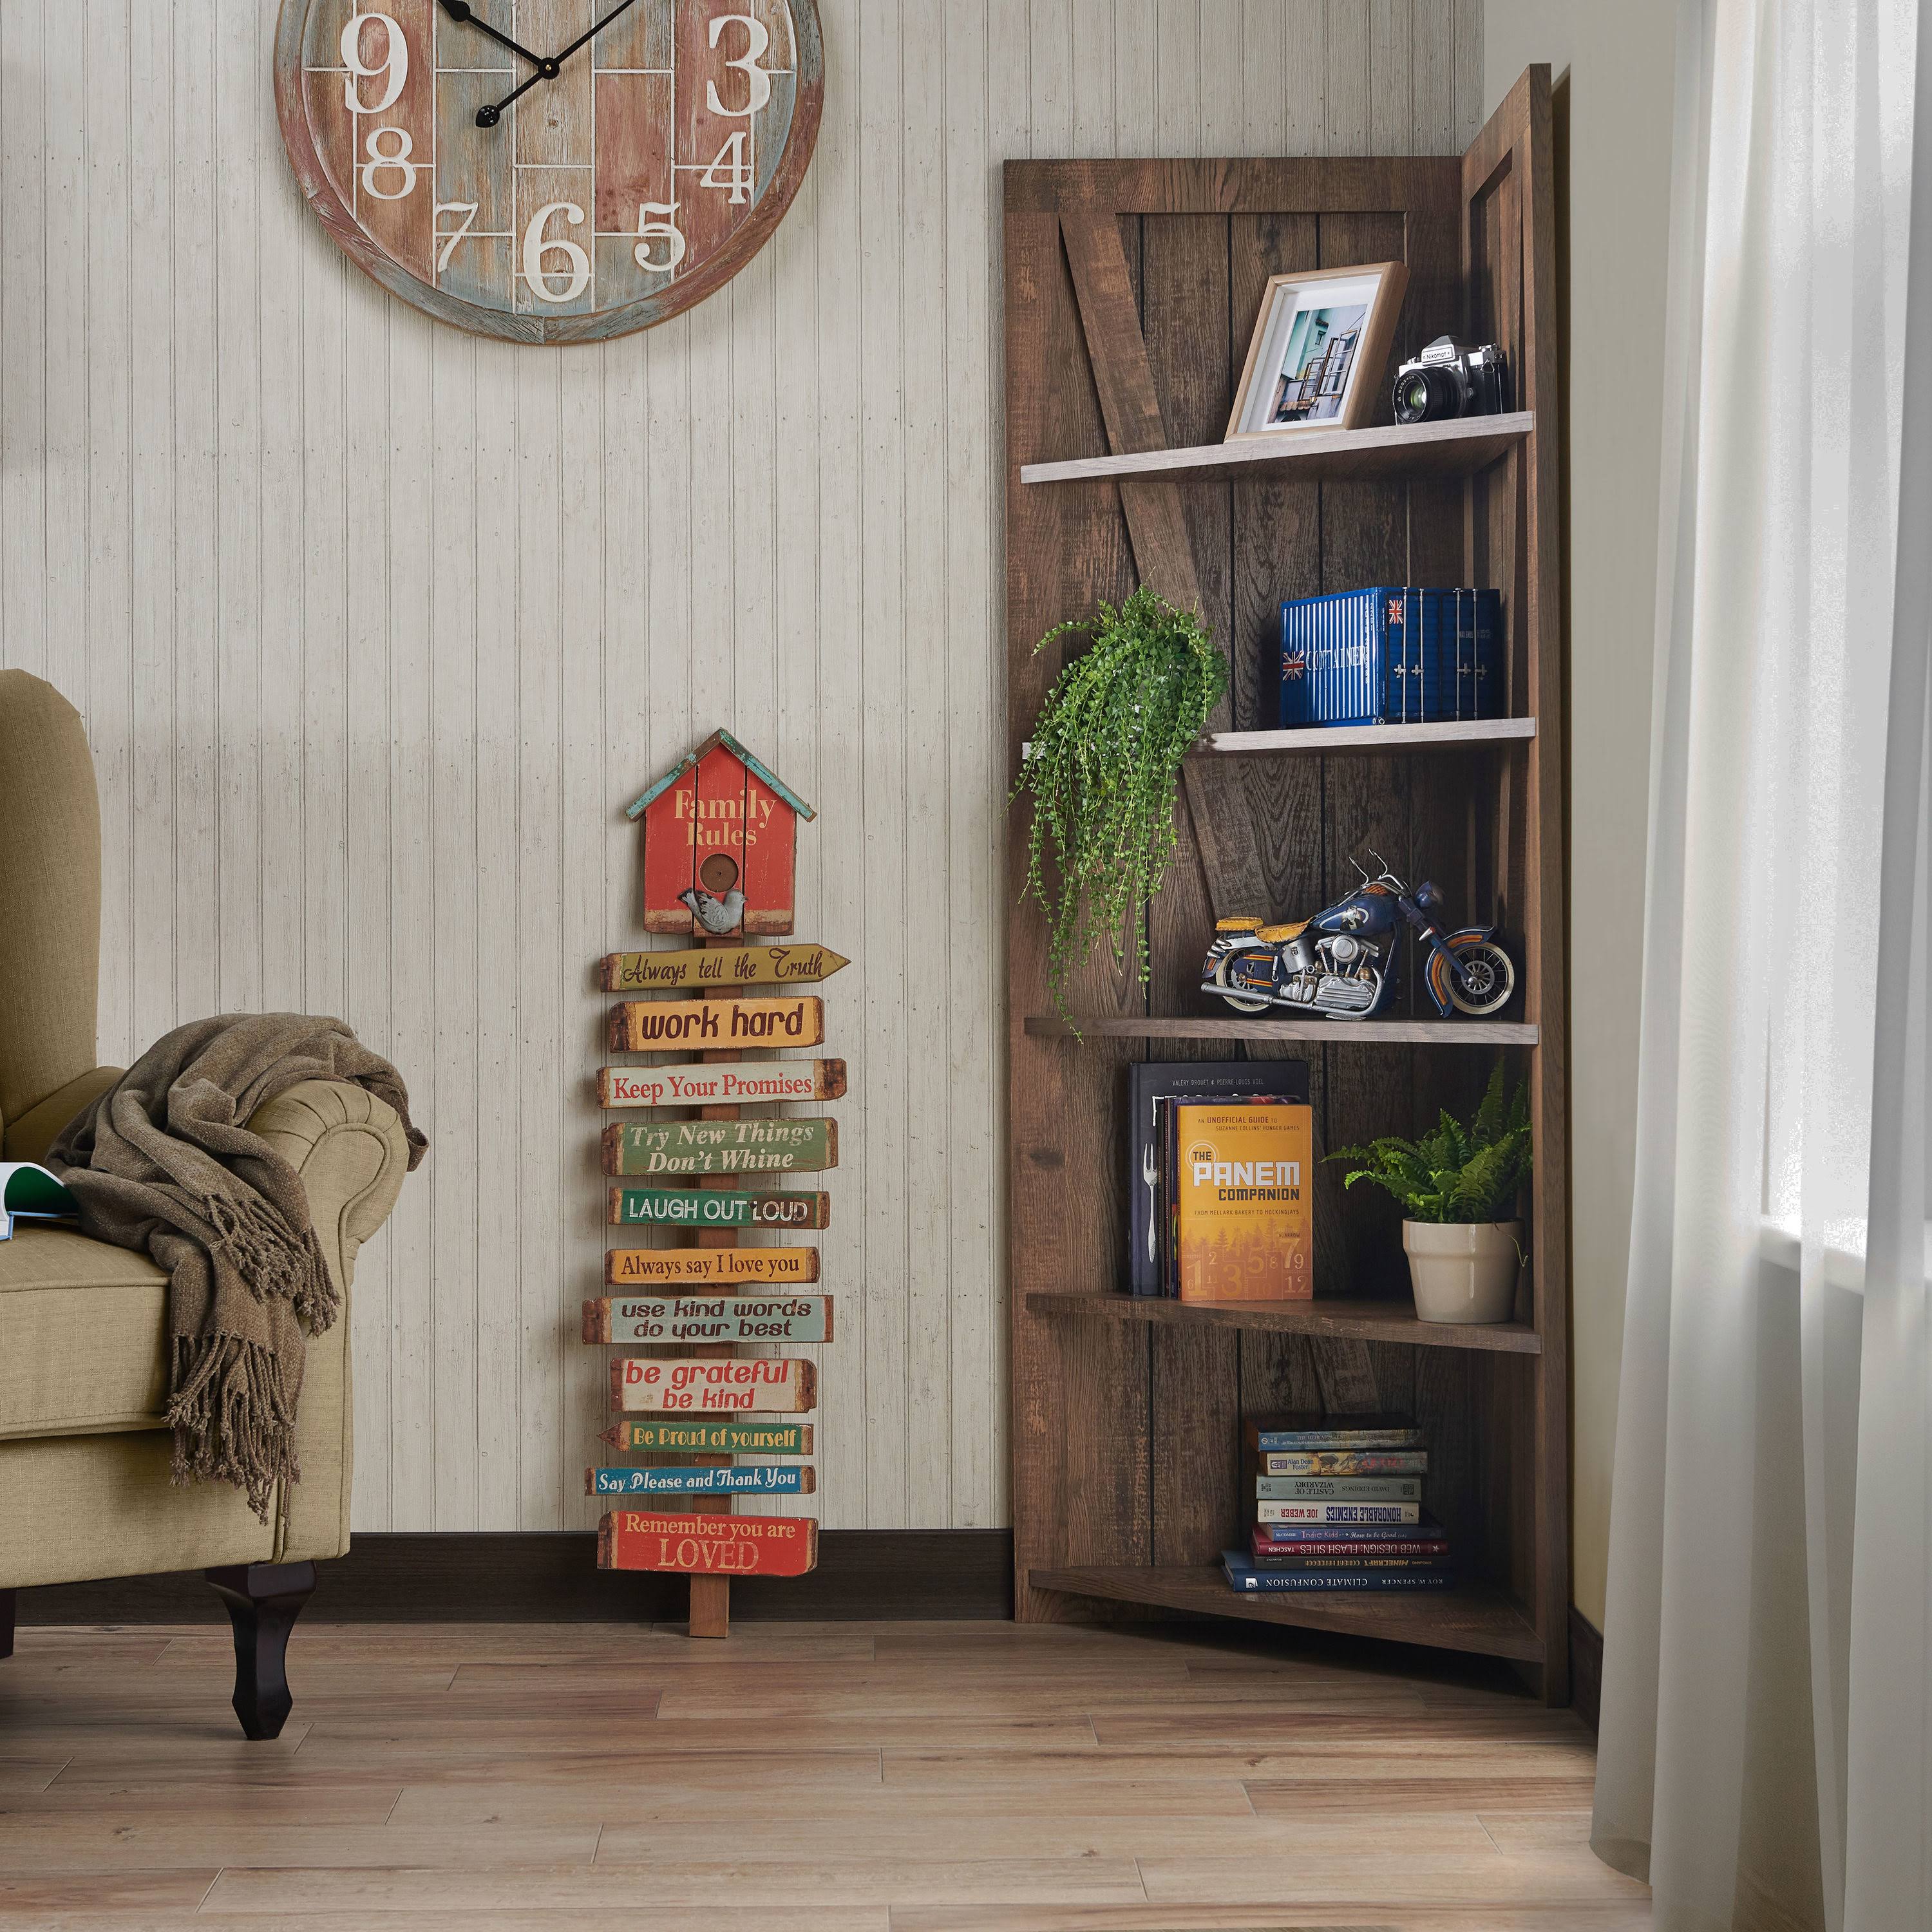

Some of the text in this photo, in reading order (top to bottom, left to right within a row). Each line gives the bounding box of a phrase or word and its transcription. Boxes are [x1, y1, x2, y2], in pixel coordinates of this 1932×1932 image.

[341, 13, 408, 113] 9
[708, 14, 771, 117] 3
[362, 127, 417, 200] 8
[699, 131, 755, 204] 4
[436, 202, 479, 272] 7
[634, 202, 685, 272] 5
[523, 202, 590, 302] 6
[1306, 645, 1366, 670] CONTAINER
[674, 790, 777, 828] Family
[687, 822, 757, 846] Rules
[623, 947, 823, 986] Always tell the Truth
[641, 1003, 804, 1039] work hard
[613, 1072, 812, 1104] Keep Your Promises
[630, 1122, 814, 1150] Try New Things
[647, 1150, 794, 1172] Don't Whine
[1193, 1151, 1212, 1160] THE
[1193, 1162, 1300, 1186] PANEM
[1218, 1188, 1300, 1201] COMPANION
[629, 1198, 808, 1221] LAUGH OUT LOUD
[1208, 1251, 1218, 1265] 2
[1278, 1238, 1300, 1269] 7
[1294, 1253, 1304, 1269] 9
[621, 1255, 800, 1279] Always say I love you
[1186, 1260, 1207, 1296] 1
[1224, 1264, 1242, 1296] 3
[621, 1299, 811, 1318] use kind words
[633, 1319, 792, 1341] do your best
[625, 1360, 790, 1388] be grateful
[662, 1388, 755, 1409] be kind
[634, 1428, 797, 1452] Be Proud of yourself
[598, 1468, 796, 1493] Say Please and Thank You
[1281, 1508, 1305, 1518] WEBER
[1307, 1509, 1318, 1518] JOE
[1326, 1506, 1401, 1522] HONORABLE ENEMIES
[625, 1513, 796, 1541] Remember you are
[658, 1538, 760, 1570] LOVED
[1300, 1544, 1421, 1554] WEB DESIGN: FLASH SITES
